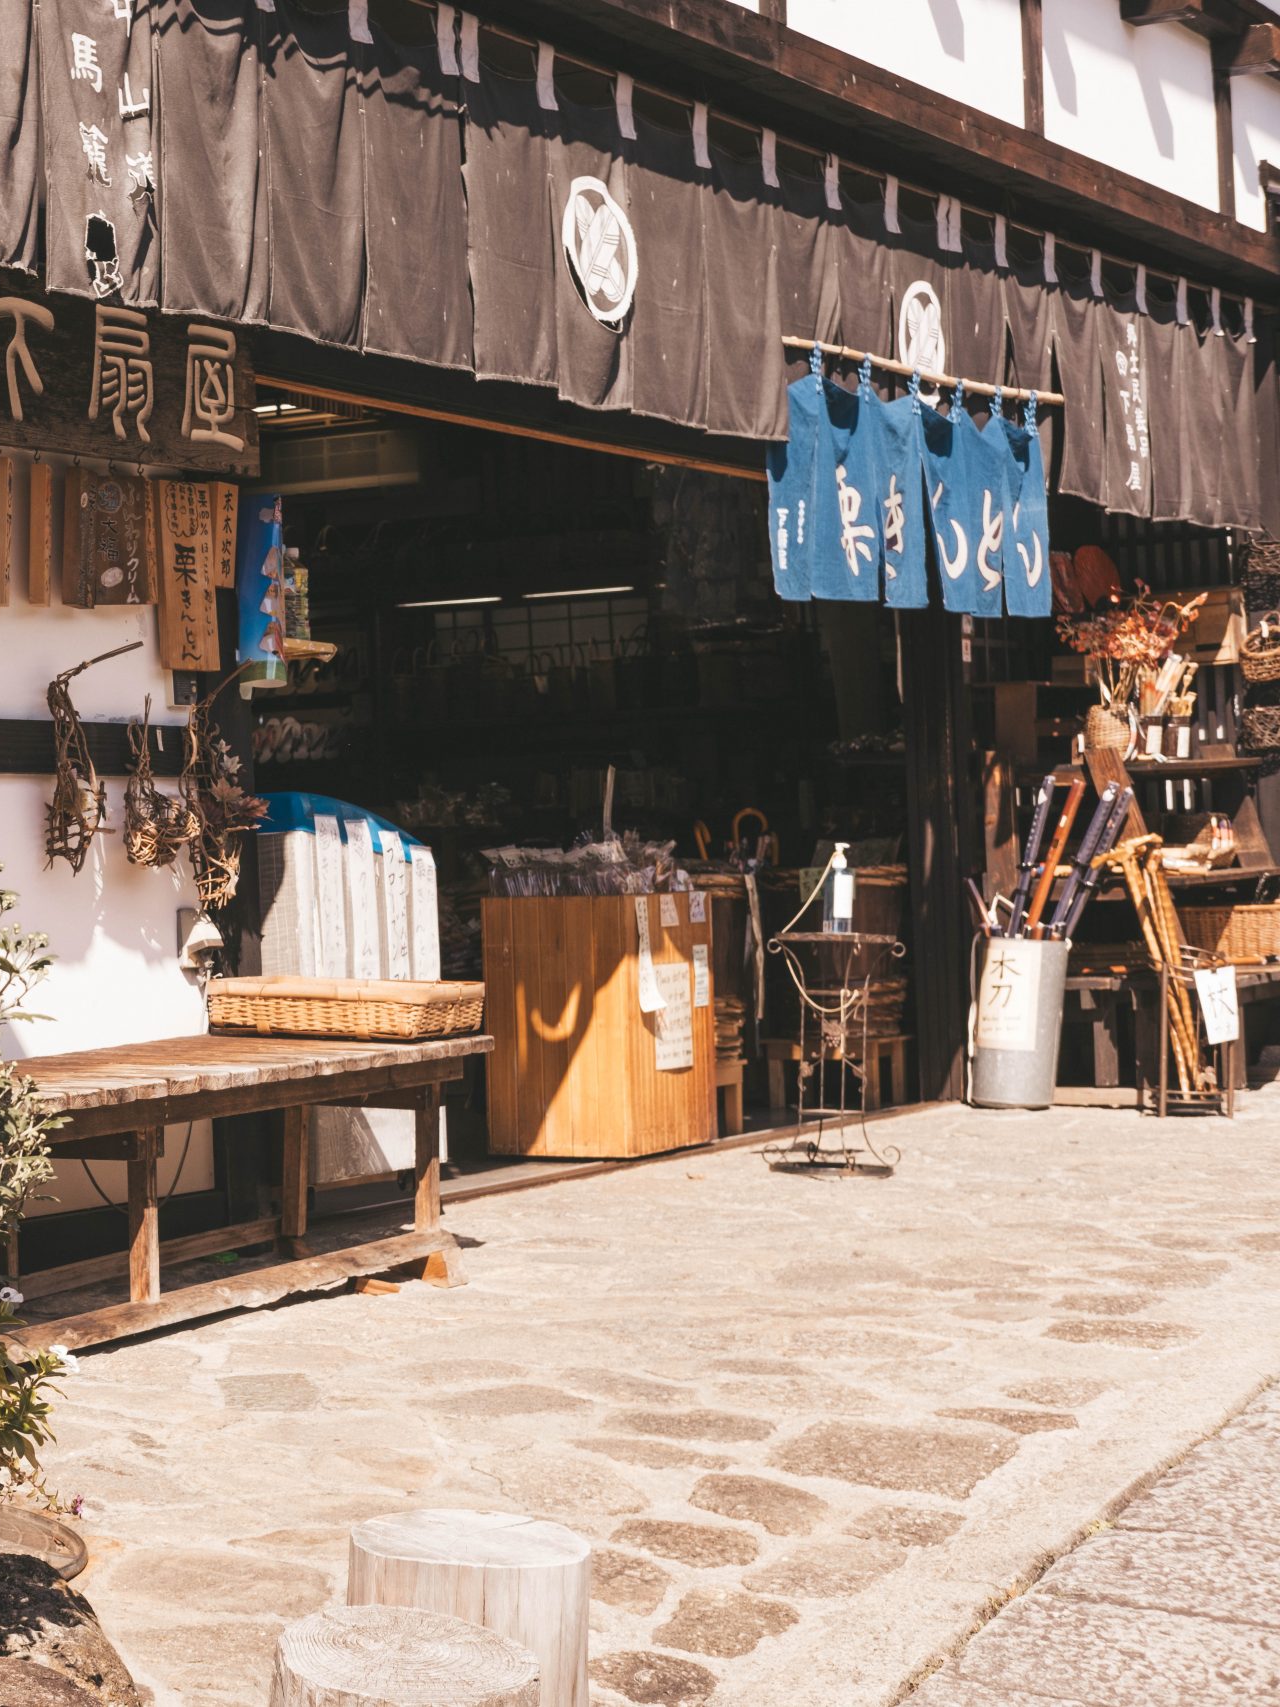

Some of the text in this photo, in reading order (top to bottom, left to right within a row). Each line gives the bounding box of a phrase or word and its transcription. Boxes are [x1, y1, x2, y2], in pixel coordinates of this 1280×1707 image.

[172, 543, 203, 663] 栗きんとん
[988, 950, 1022, 1008] 木刀
